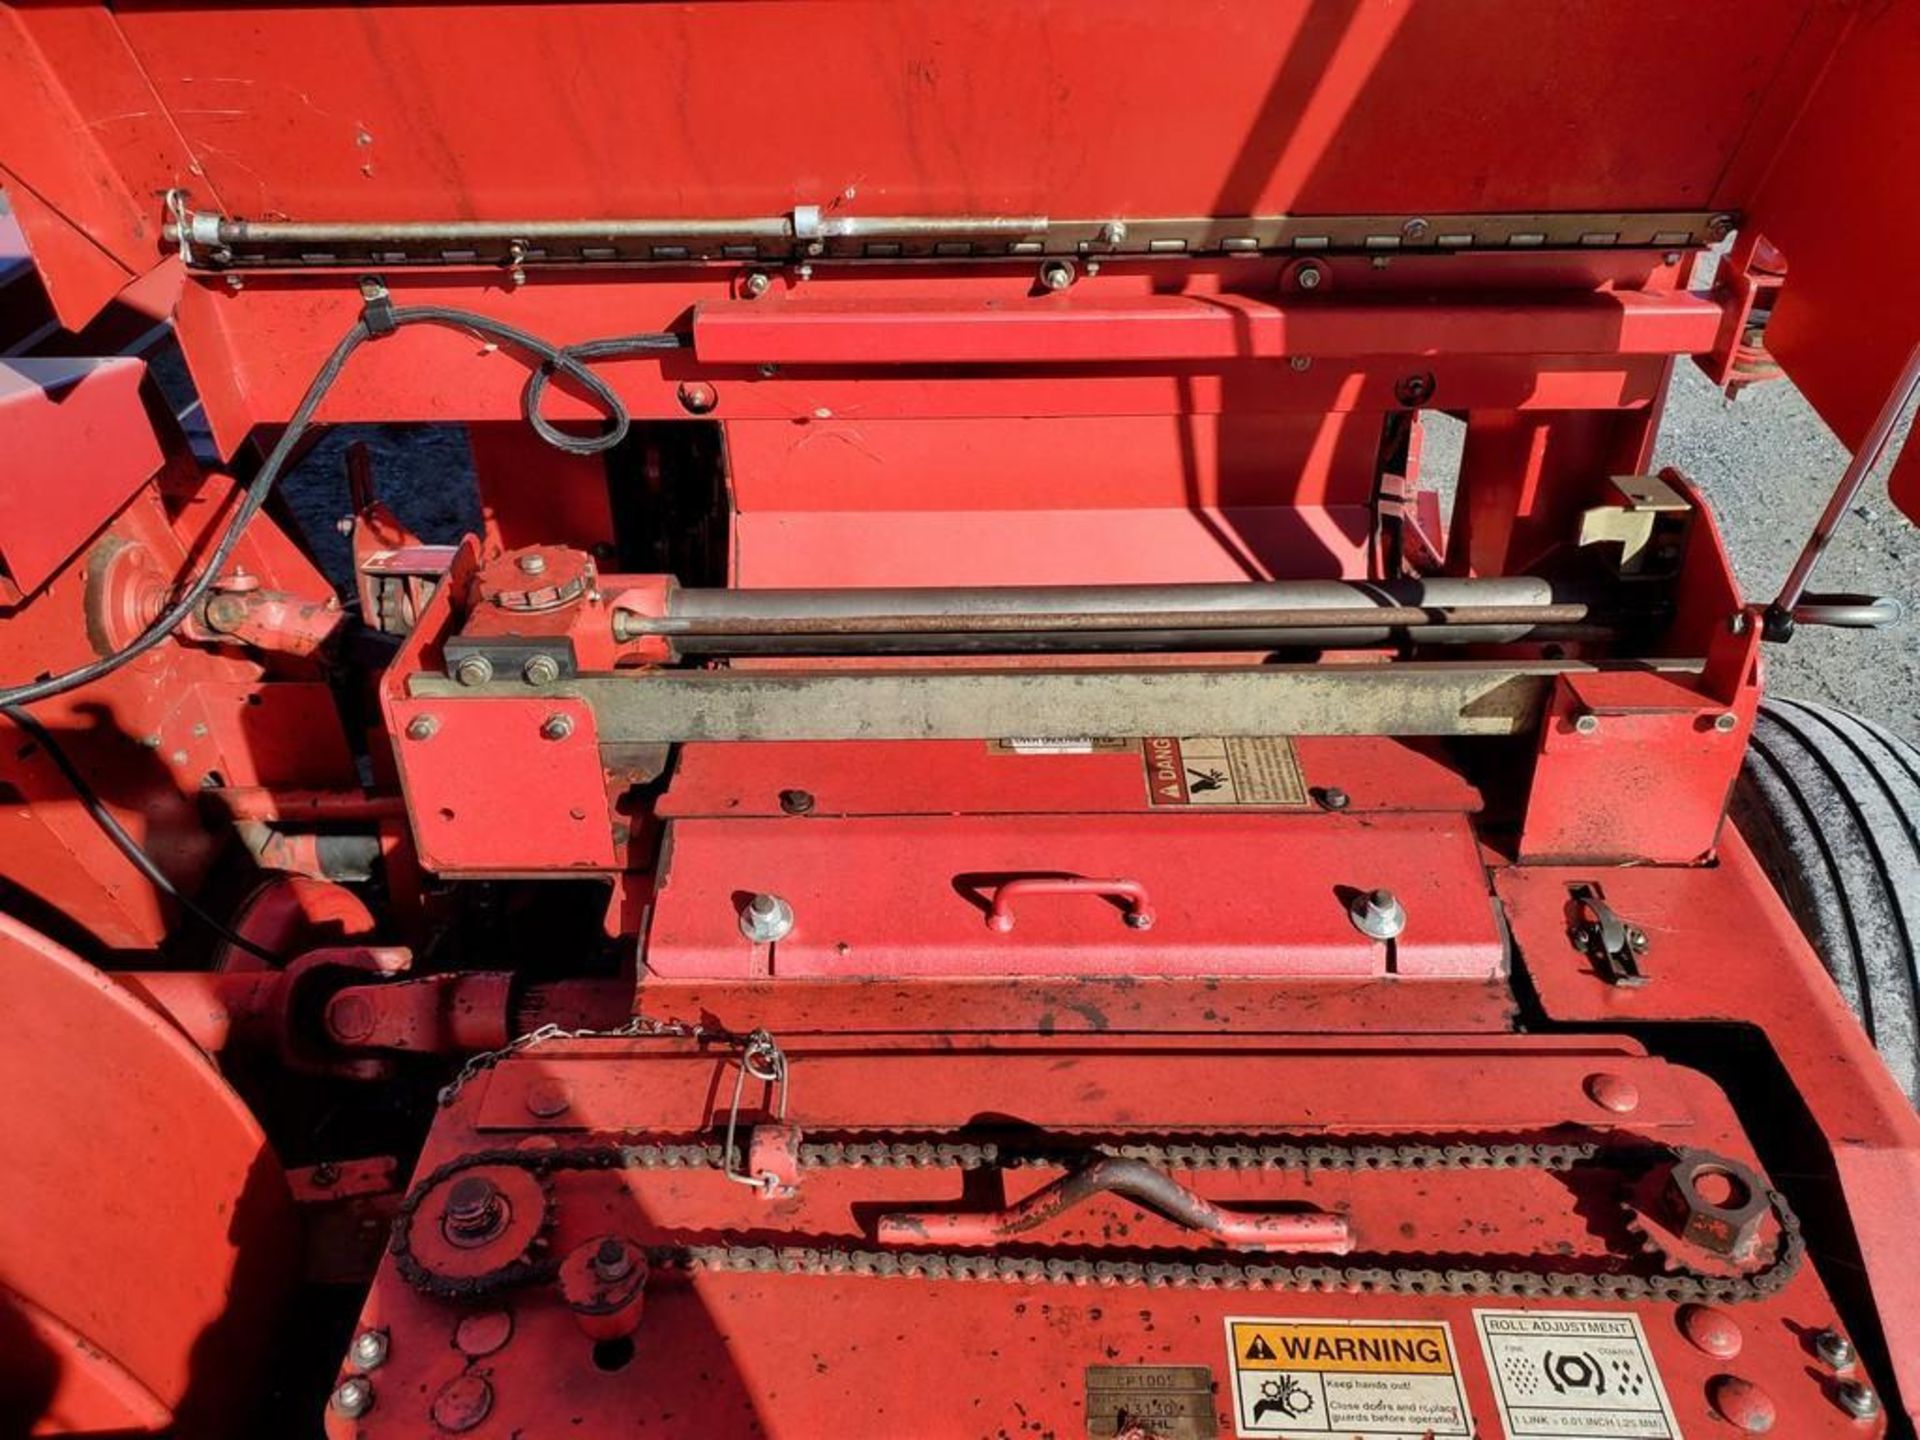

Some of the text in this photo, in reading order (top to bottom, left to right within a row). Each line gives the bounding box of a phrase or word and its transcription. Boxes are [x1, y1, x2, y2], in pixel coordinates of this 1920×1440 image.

[1153, 738, 1177, 780] DANG
[1489, 1320, 1627, 1334] ROLL ADJUSTMENT
[1281, 1336, 1442, 1363] WARNING
[1326, 1379, 1412, 1391] Keep hands out!
[1329, 1401, 1458, 1415] Close doors and replace
[1331, 1412, 1369, 1424] guards
[1371, 1413, 1406, 1423] before
[1522, 1415, 1549, 1425] LINK
[1561, 1416, 1584, 1426] 0.01
[1585, 1417, 1614, 1427] INCH
